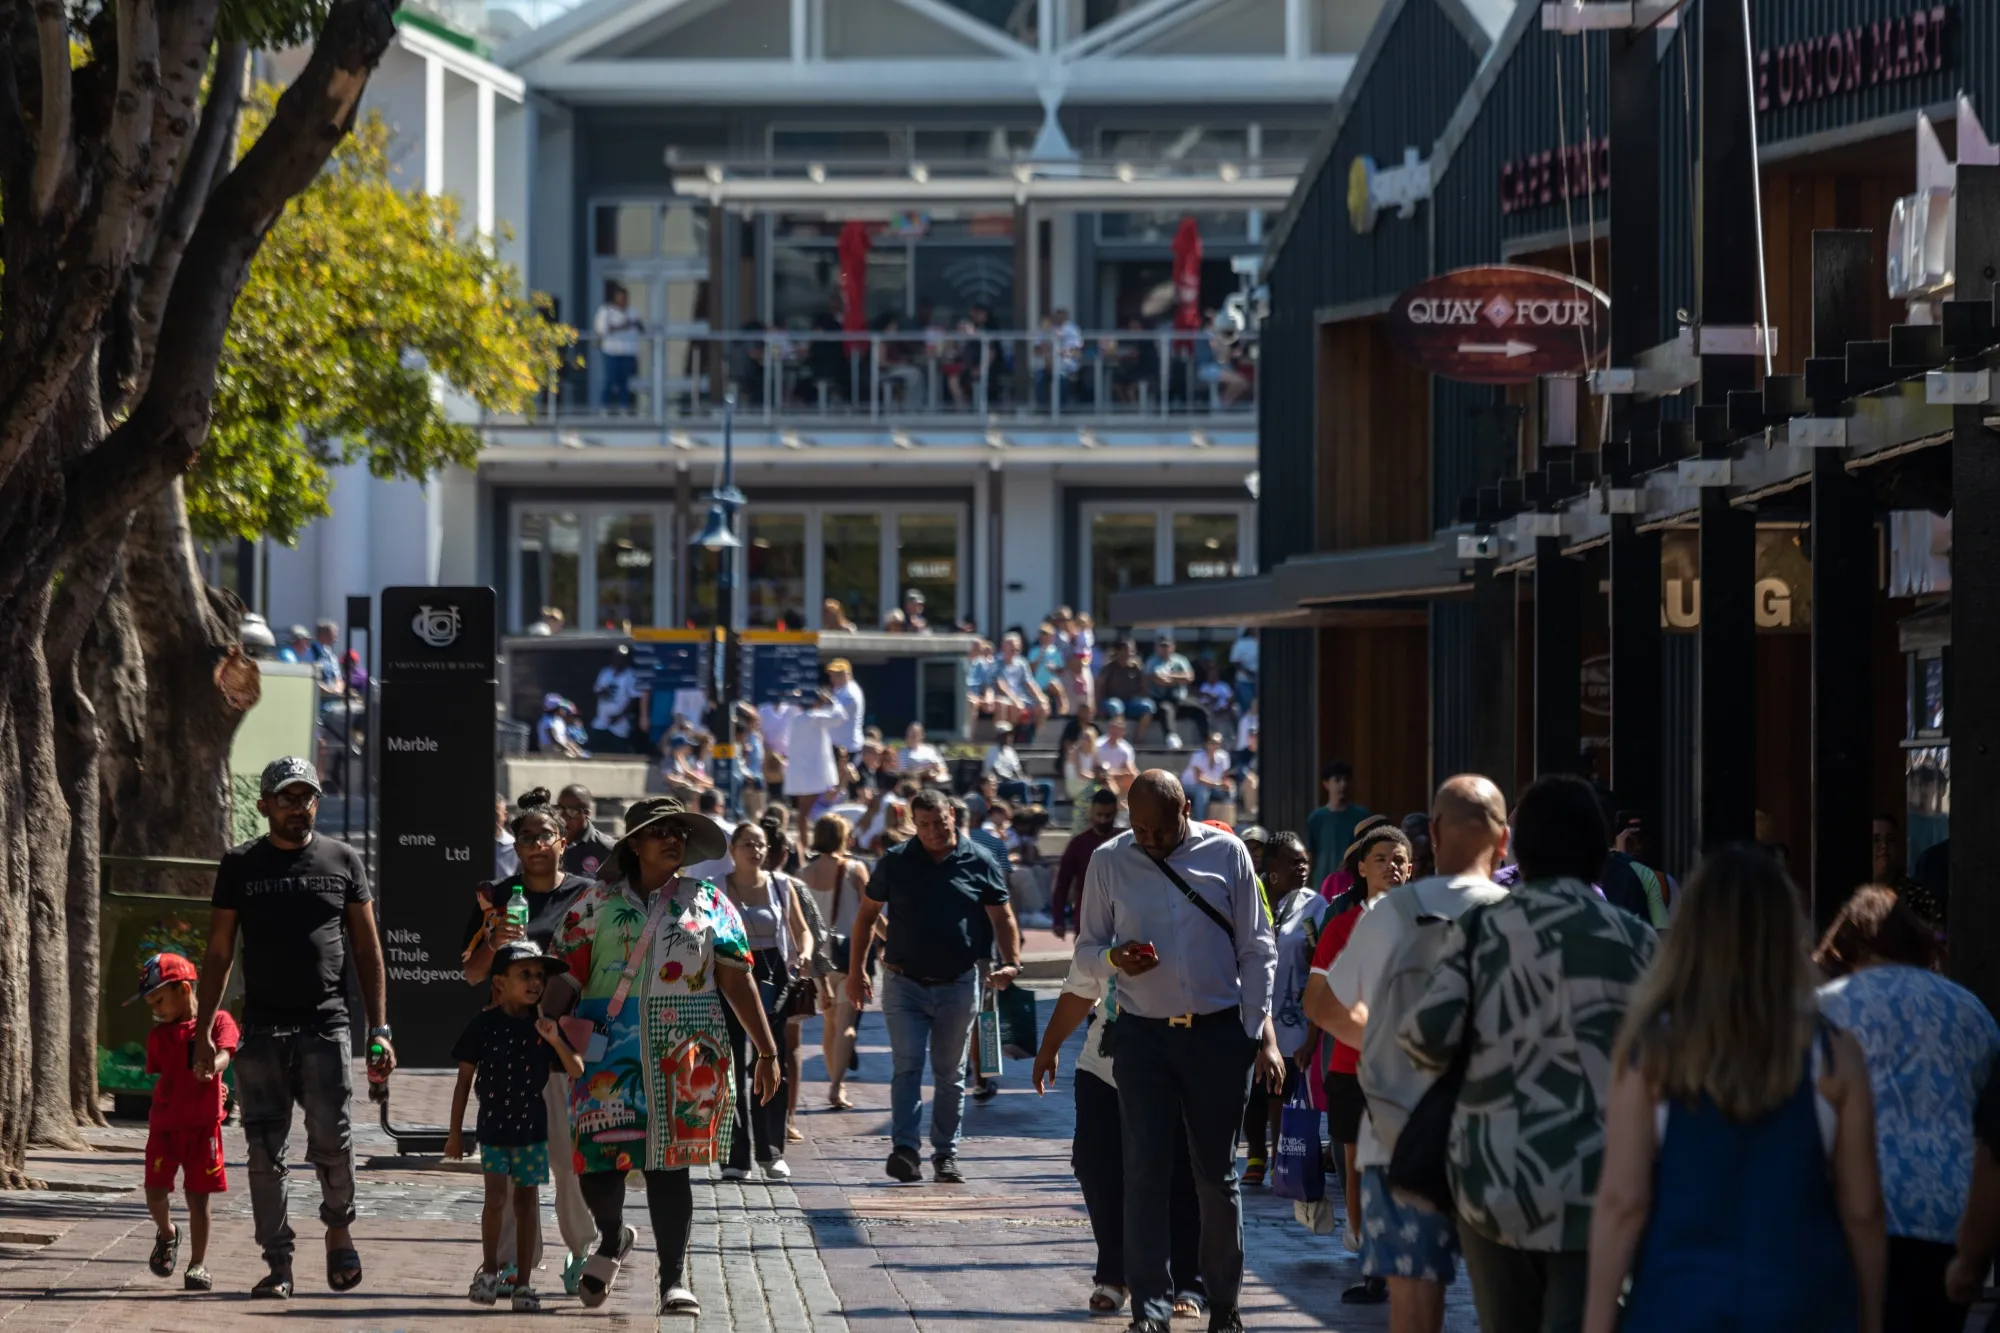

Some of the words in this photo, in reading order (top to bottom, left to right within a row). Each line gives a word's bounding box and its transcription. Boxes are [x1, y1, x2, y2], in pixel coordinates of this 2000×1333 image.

[1777, 27, 1863, 106] UNION
[1871, 6, 1946, 85] MART
[1407, 299, 1484, 325] QUAY
[1515, 301, 1590, 326] FOUR
[387, 736, 439, 752] Marble
[445, 846, 470, 861] Ltd
[387, 928, 421, 944] Nike
[388, 946, 429, 962] Thule
